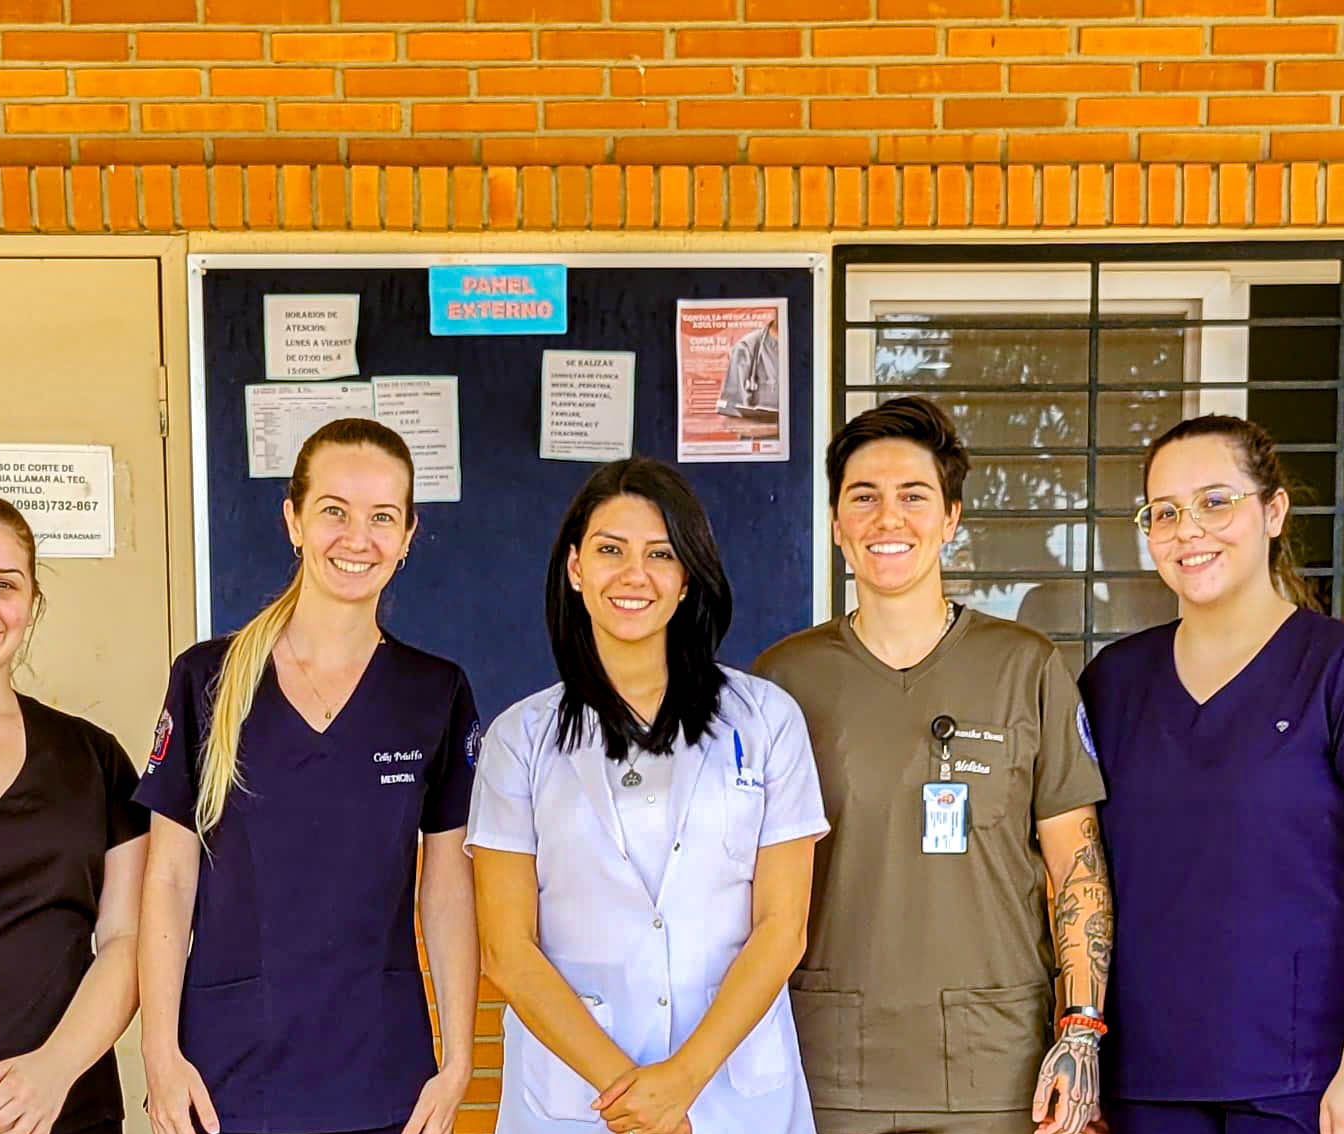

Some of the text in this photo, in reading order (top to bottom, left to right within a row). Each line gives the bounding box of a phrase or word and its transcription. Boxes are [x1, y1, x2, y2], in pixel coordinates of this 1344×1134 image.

[462, 276, 535, 295] PANEL
[447, 300, 553, 319] EXTERNO
[285, 311, 325, 319] HORARIOS
[13, 463, 25, 472] DE
[27, 464, 59, 473] CORTE
[61, 464, 74, 473] DE
[13, 474, 51, 483] LLAMAR
[53, 475, 65, 483] AL
